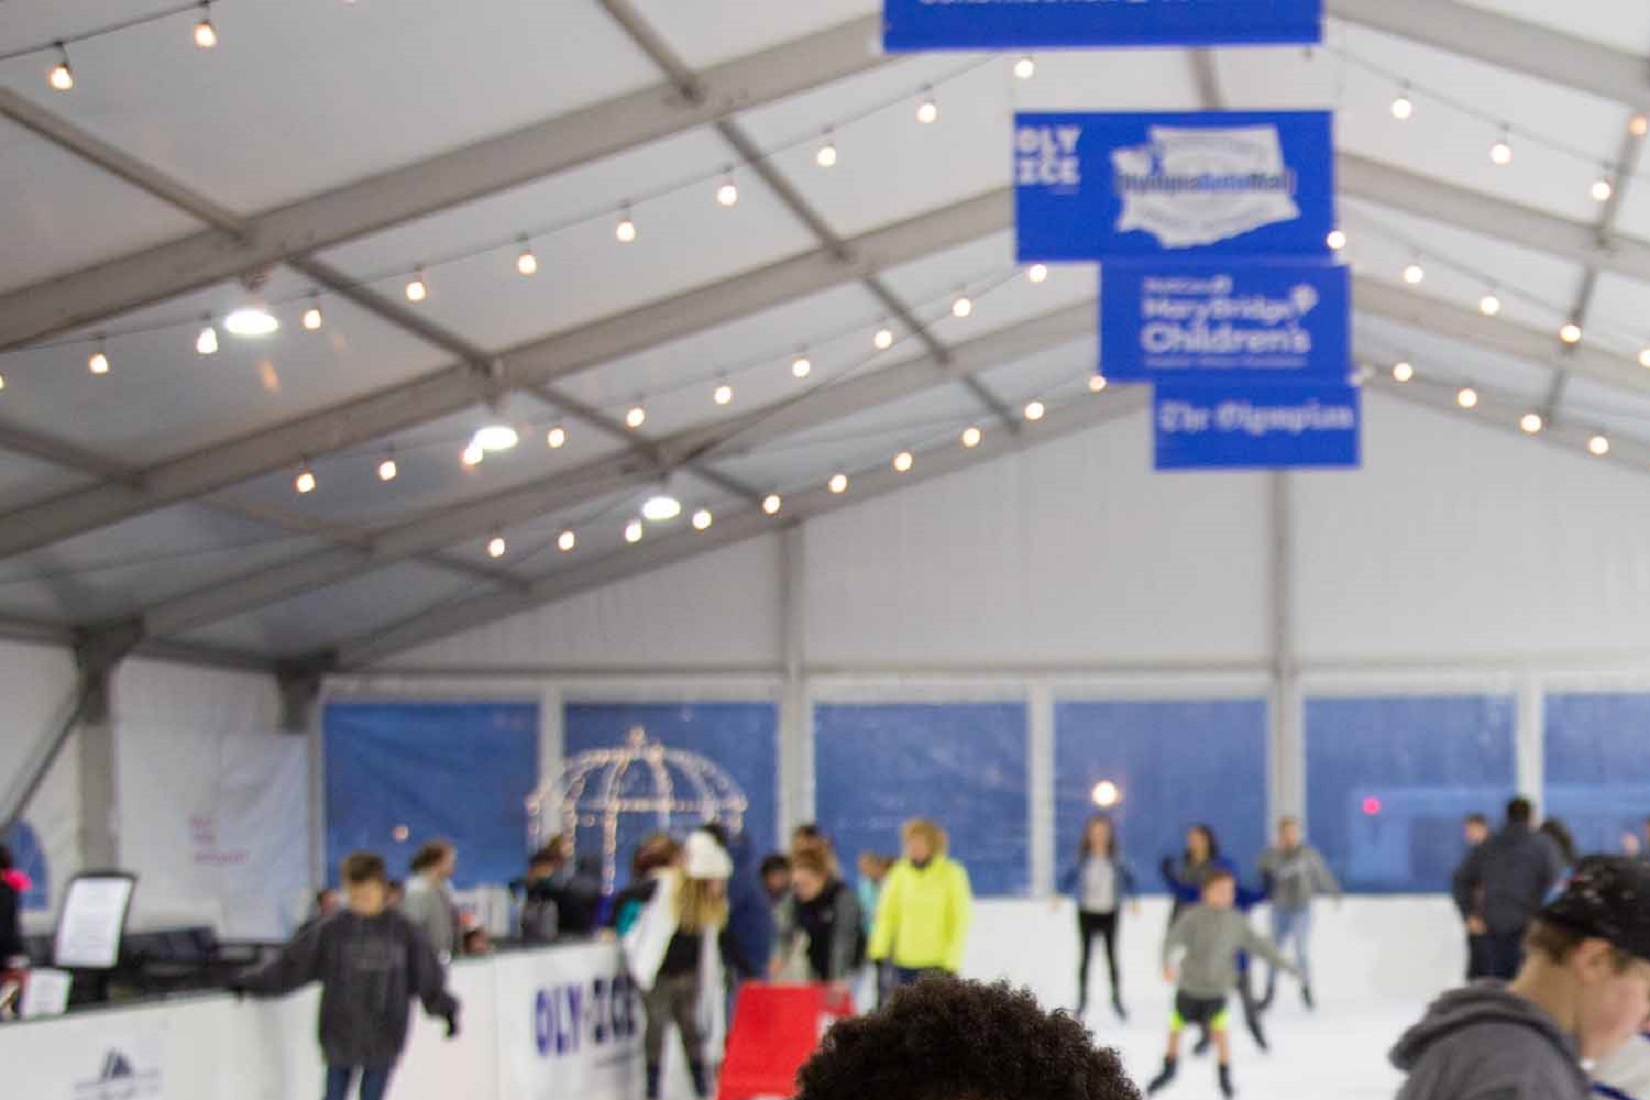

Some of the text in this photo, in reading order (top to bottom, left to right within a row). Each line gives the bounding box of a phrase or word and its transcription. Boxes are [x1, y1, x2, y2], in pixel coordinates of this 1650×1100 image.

[1016, 124, 1082, 154] OLY
[1016, 155, 1080, 187] ICE
[1141, 321, 1312, 354] Children's
[1159, 400, 1356, 437] The Olympian
[534, 985, 583, 1056] OLY
